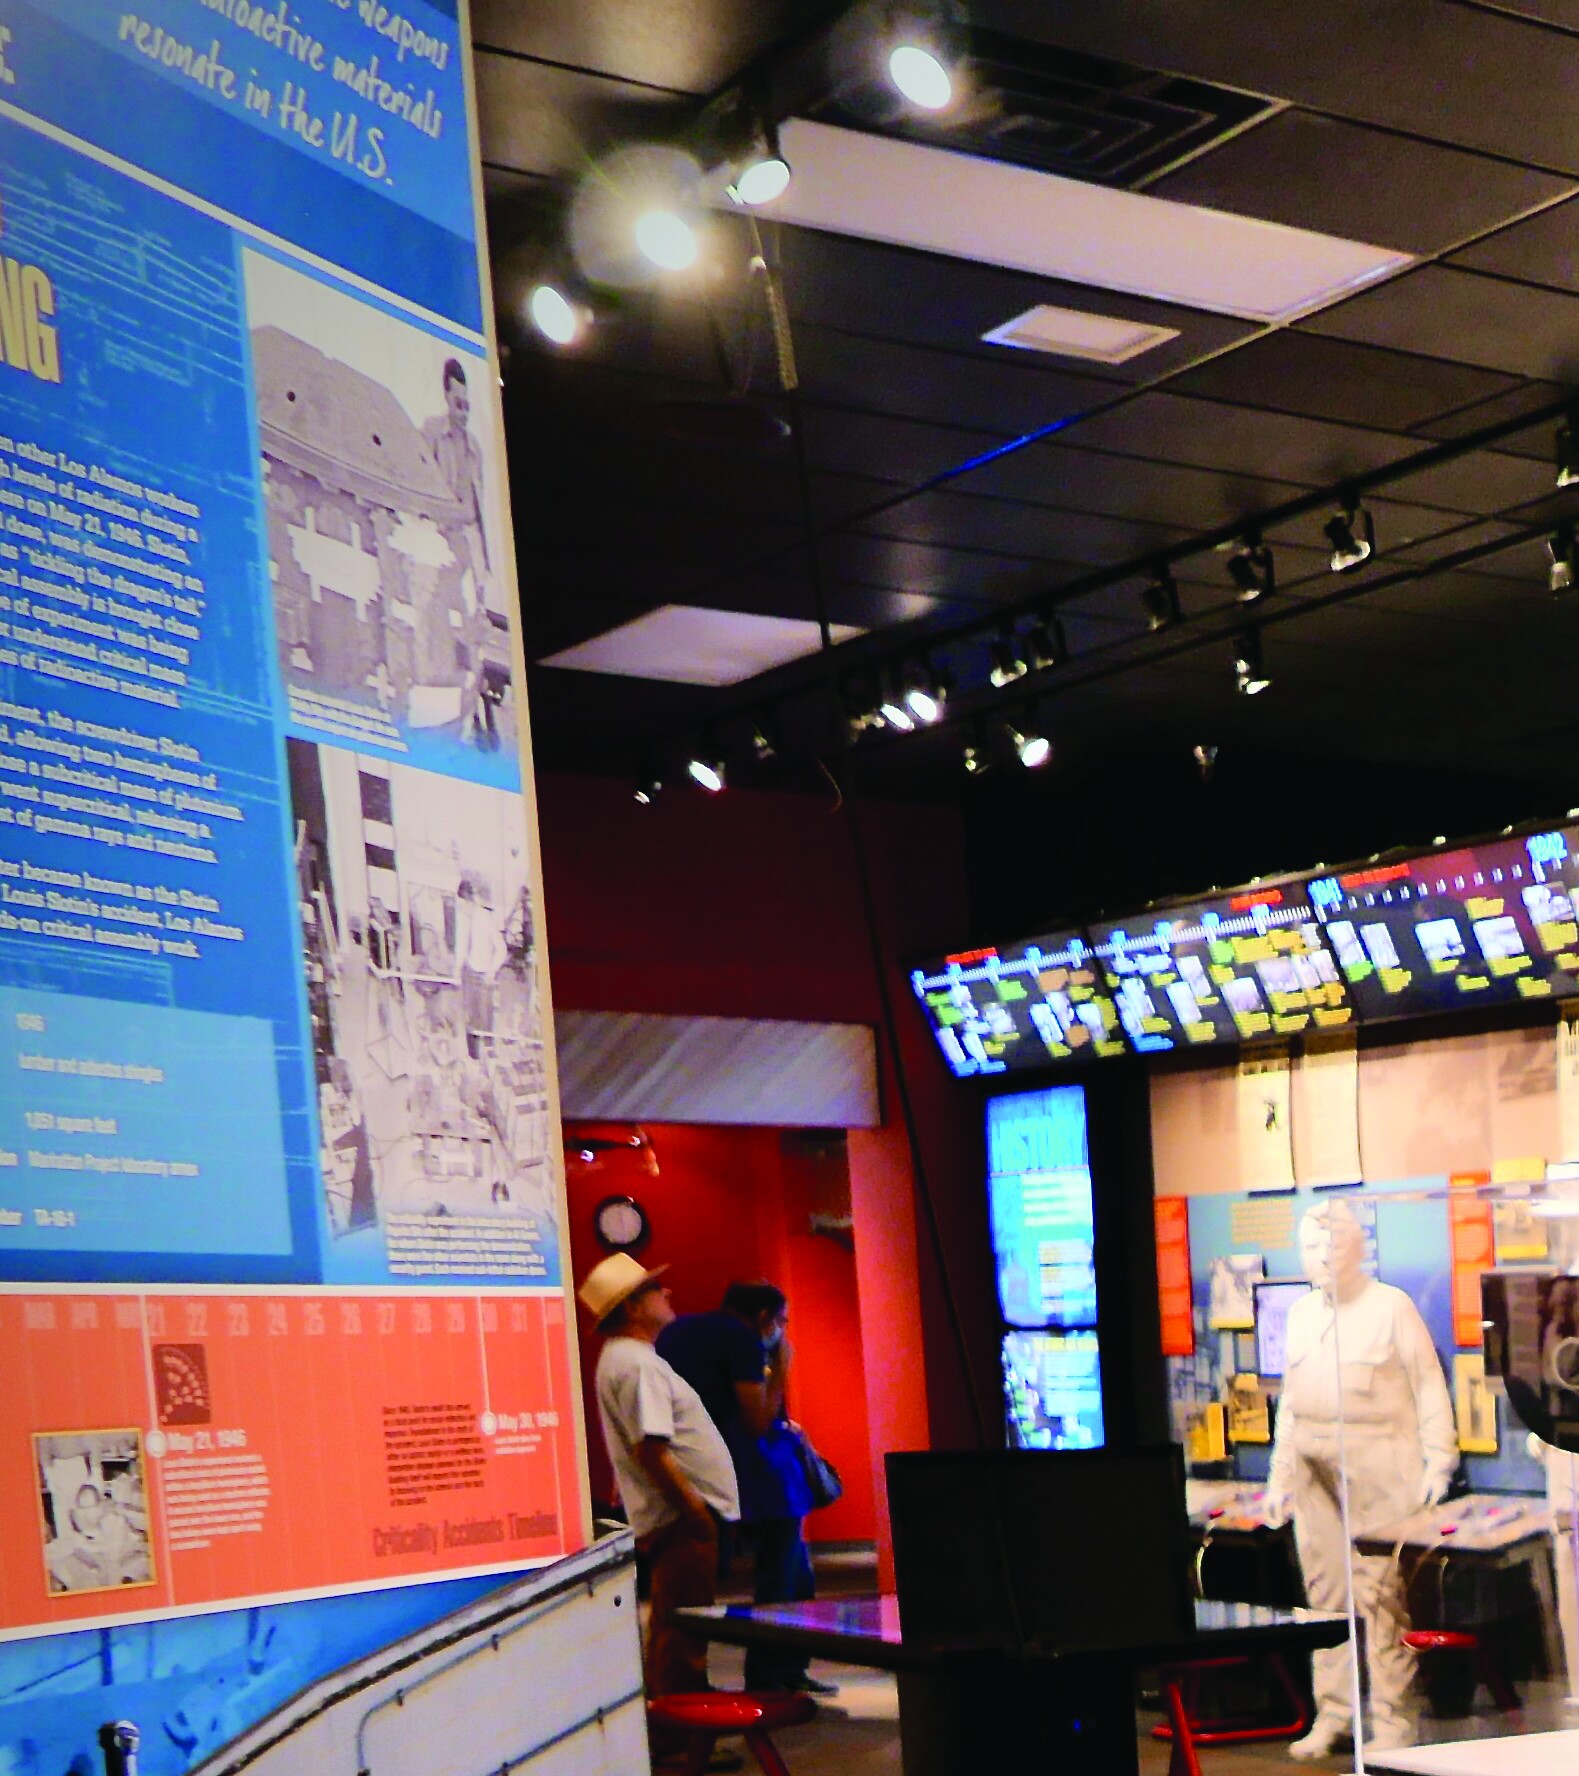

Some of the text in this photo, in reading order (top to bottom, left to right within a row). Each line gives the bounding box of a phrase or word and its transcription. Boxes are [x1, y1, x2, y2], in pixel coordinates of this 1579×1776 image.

[358, 0, 449, 70] weapons
[119, 13, 394, 186] resonate in the U.S.
[332, 55, 443, 139] materials
[16, 442, 56, 467] other
[58, 453, 86, 478] Los
[89, 465, 143, 498] Alamos
[49, 501, 82, 531] May
[58, 482, 74, 499] of
[76, 489, 139, 522] radiation
[141, 508, 187, 542] during
[49, 531, 80, 553] was
[83, 540, 183, 589] demonstrating
[87, 567, 111, 589] the
[21, 576, 90, 611] assembly
[92, 593, 108, 613] is
[108, 597, 163, 629] brought
[12, 626, 97, 661] understand
[99, 650, 148, 675] critical
[14, 598, 189, 665] of experiment was being
[20, 652, 37, 670] of
[39, 659, 118, 691] radioactive
[16, 730, 217, 791] allowing two hemispheres of
[48, 711, 73, 732] the
[76, 721, 158, 752] screwdriver
[159, 737, 200, 762] Slotin
[41, 764, 118, 793] subcritical
[159, 788, 174, 806] of
[16, 810, 32, 827] of
[35, 815, 92, 838] gamma
[93, 827, 123, 846] rays
[126, 834, 155, 852] and
[22, 860, 82, 888] became
[83, 872, 134, 897] known
[135, 886, 153, 900] as
[154, 886, 179, 905] the
[1, 883, 45, 907] Louis
[165, 912, 191, 932] Los
[193, 918, 244, 941] Alamos
[42, 920, 93, 942] critical
[94, 929, 161, 955] assembly
[989, 1111, 1086, 1172] HISTORY
[167, 1429, 247, 1454] May 21, 1946
[498, 1413, 518, 1432] May
[536, 1411, 559, 1427] 1946
[373, 1511, 557, 1556] Criticality Accidents Timeline
